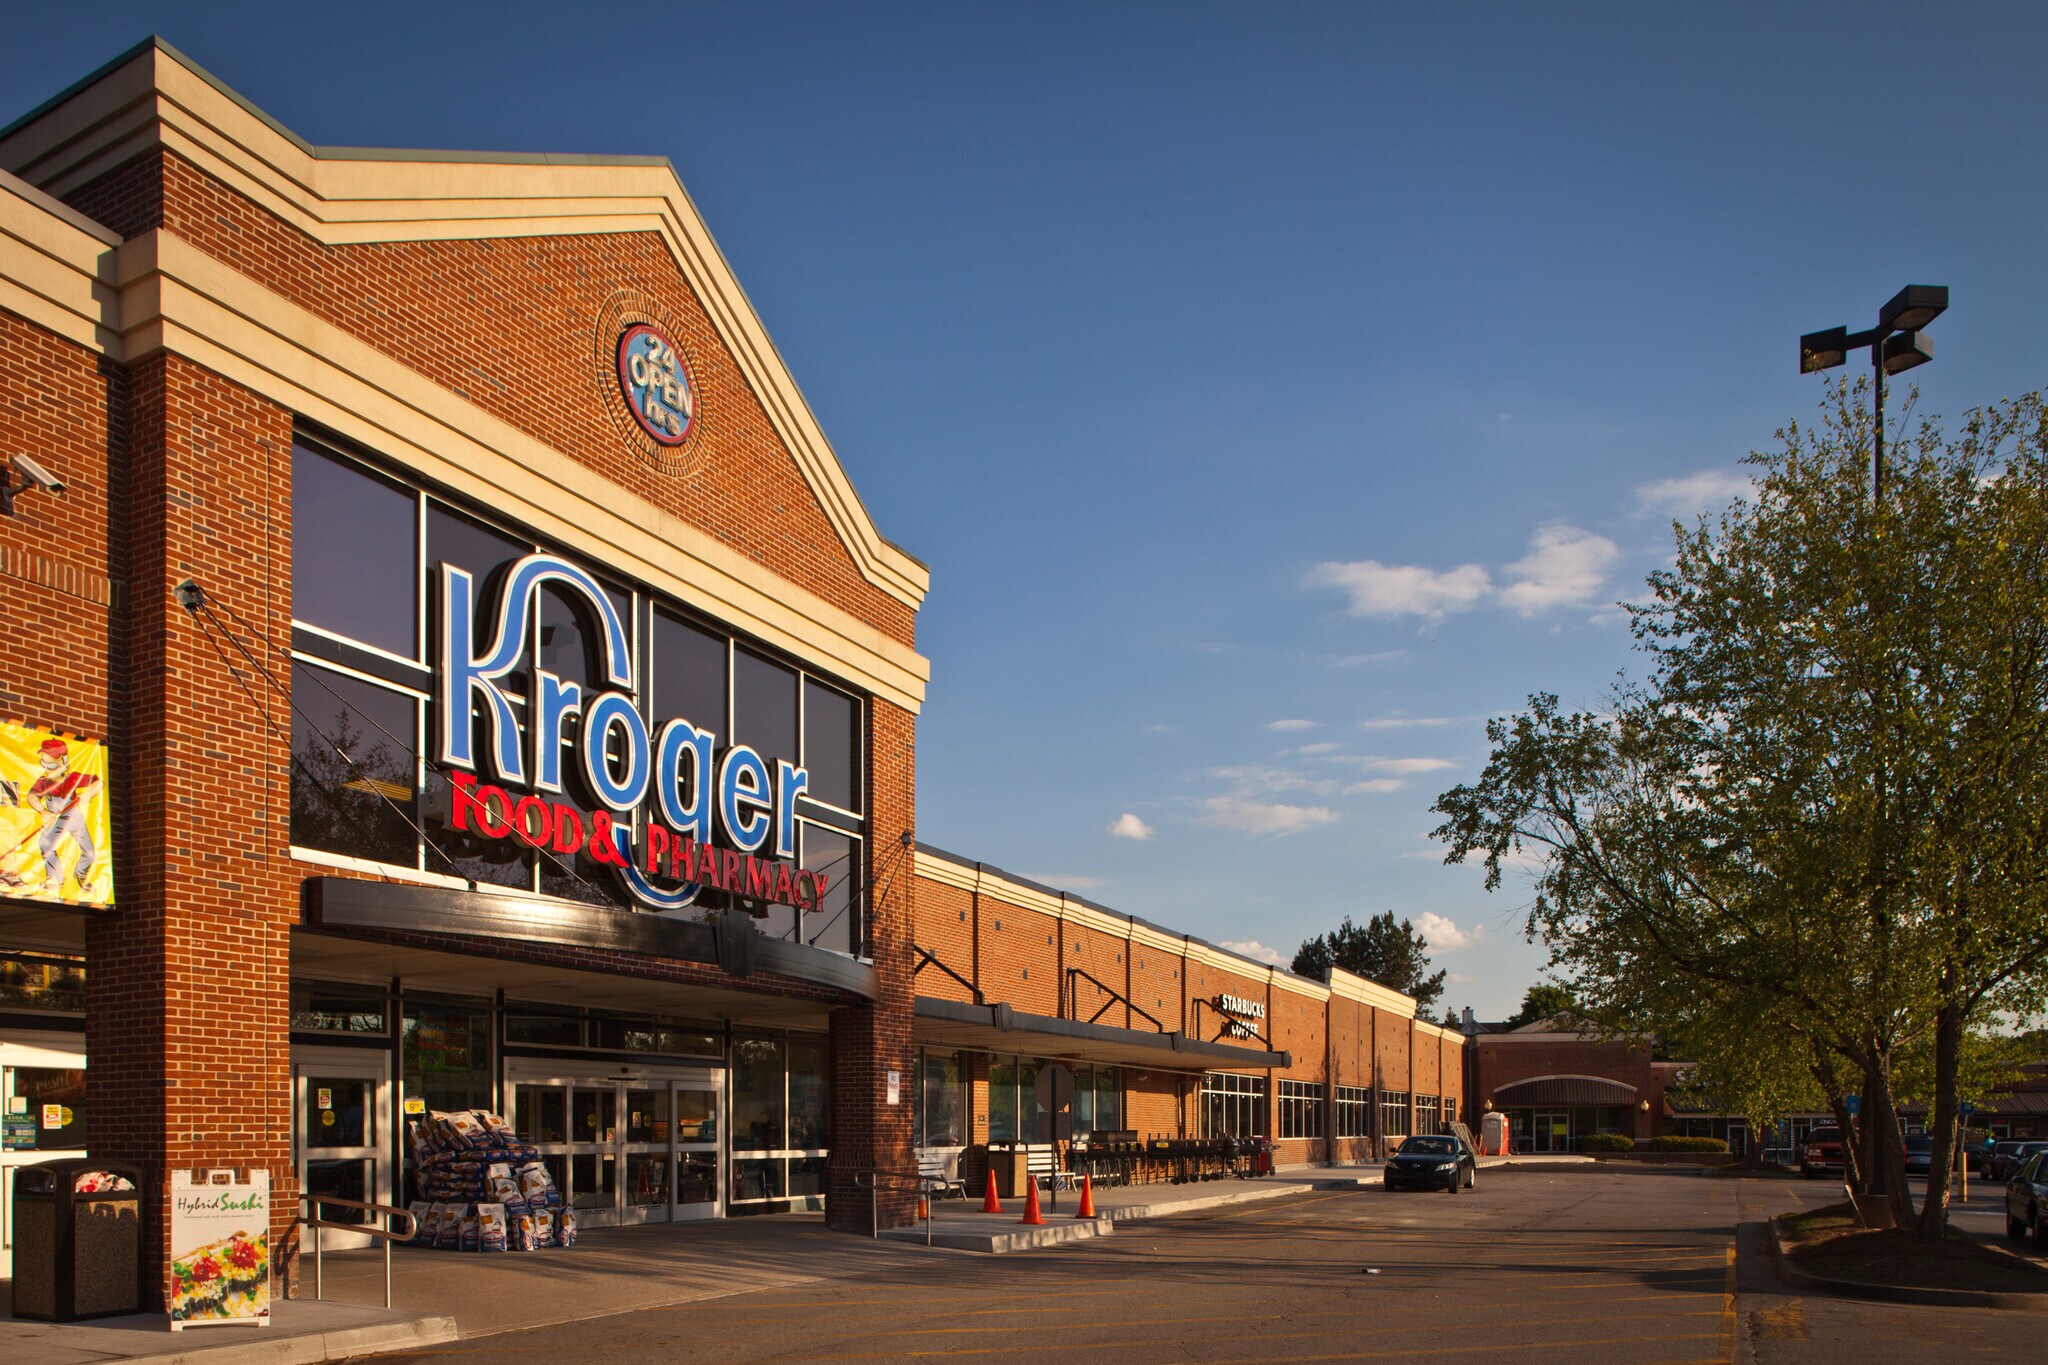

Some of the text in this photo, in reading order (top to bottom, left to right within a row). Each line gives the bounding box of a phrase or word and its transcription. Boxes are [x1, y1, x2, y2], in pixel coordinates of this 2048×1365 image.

[645, 335, 676, 374] 24
[629, 353, 694, 419] OPEN
[440, 554, 808, 908] Kroger
[450, 770, 829, 912] FOOD & PHARMACY
[1222, 994, 1265, 1019] STARBUCKS
[1231, 1020, 1259, 1038] COFFEE
[177, 1192, 264, 1214] Hybrid Sushi
